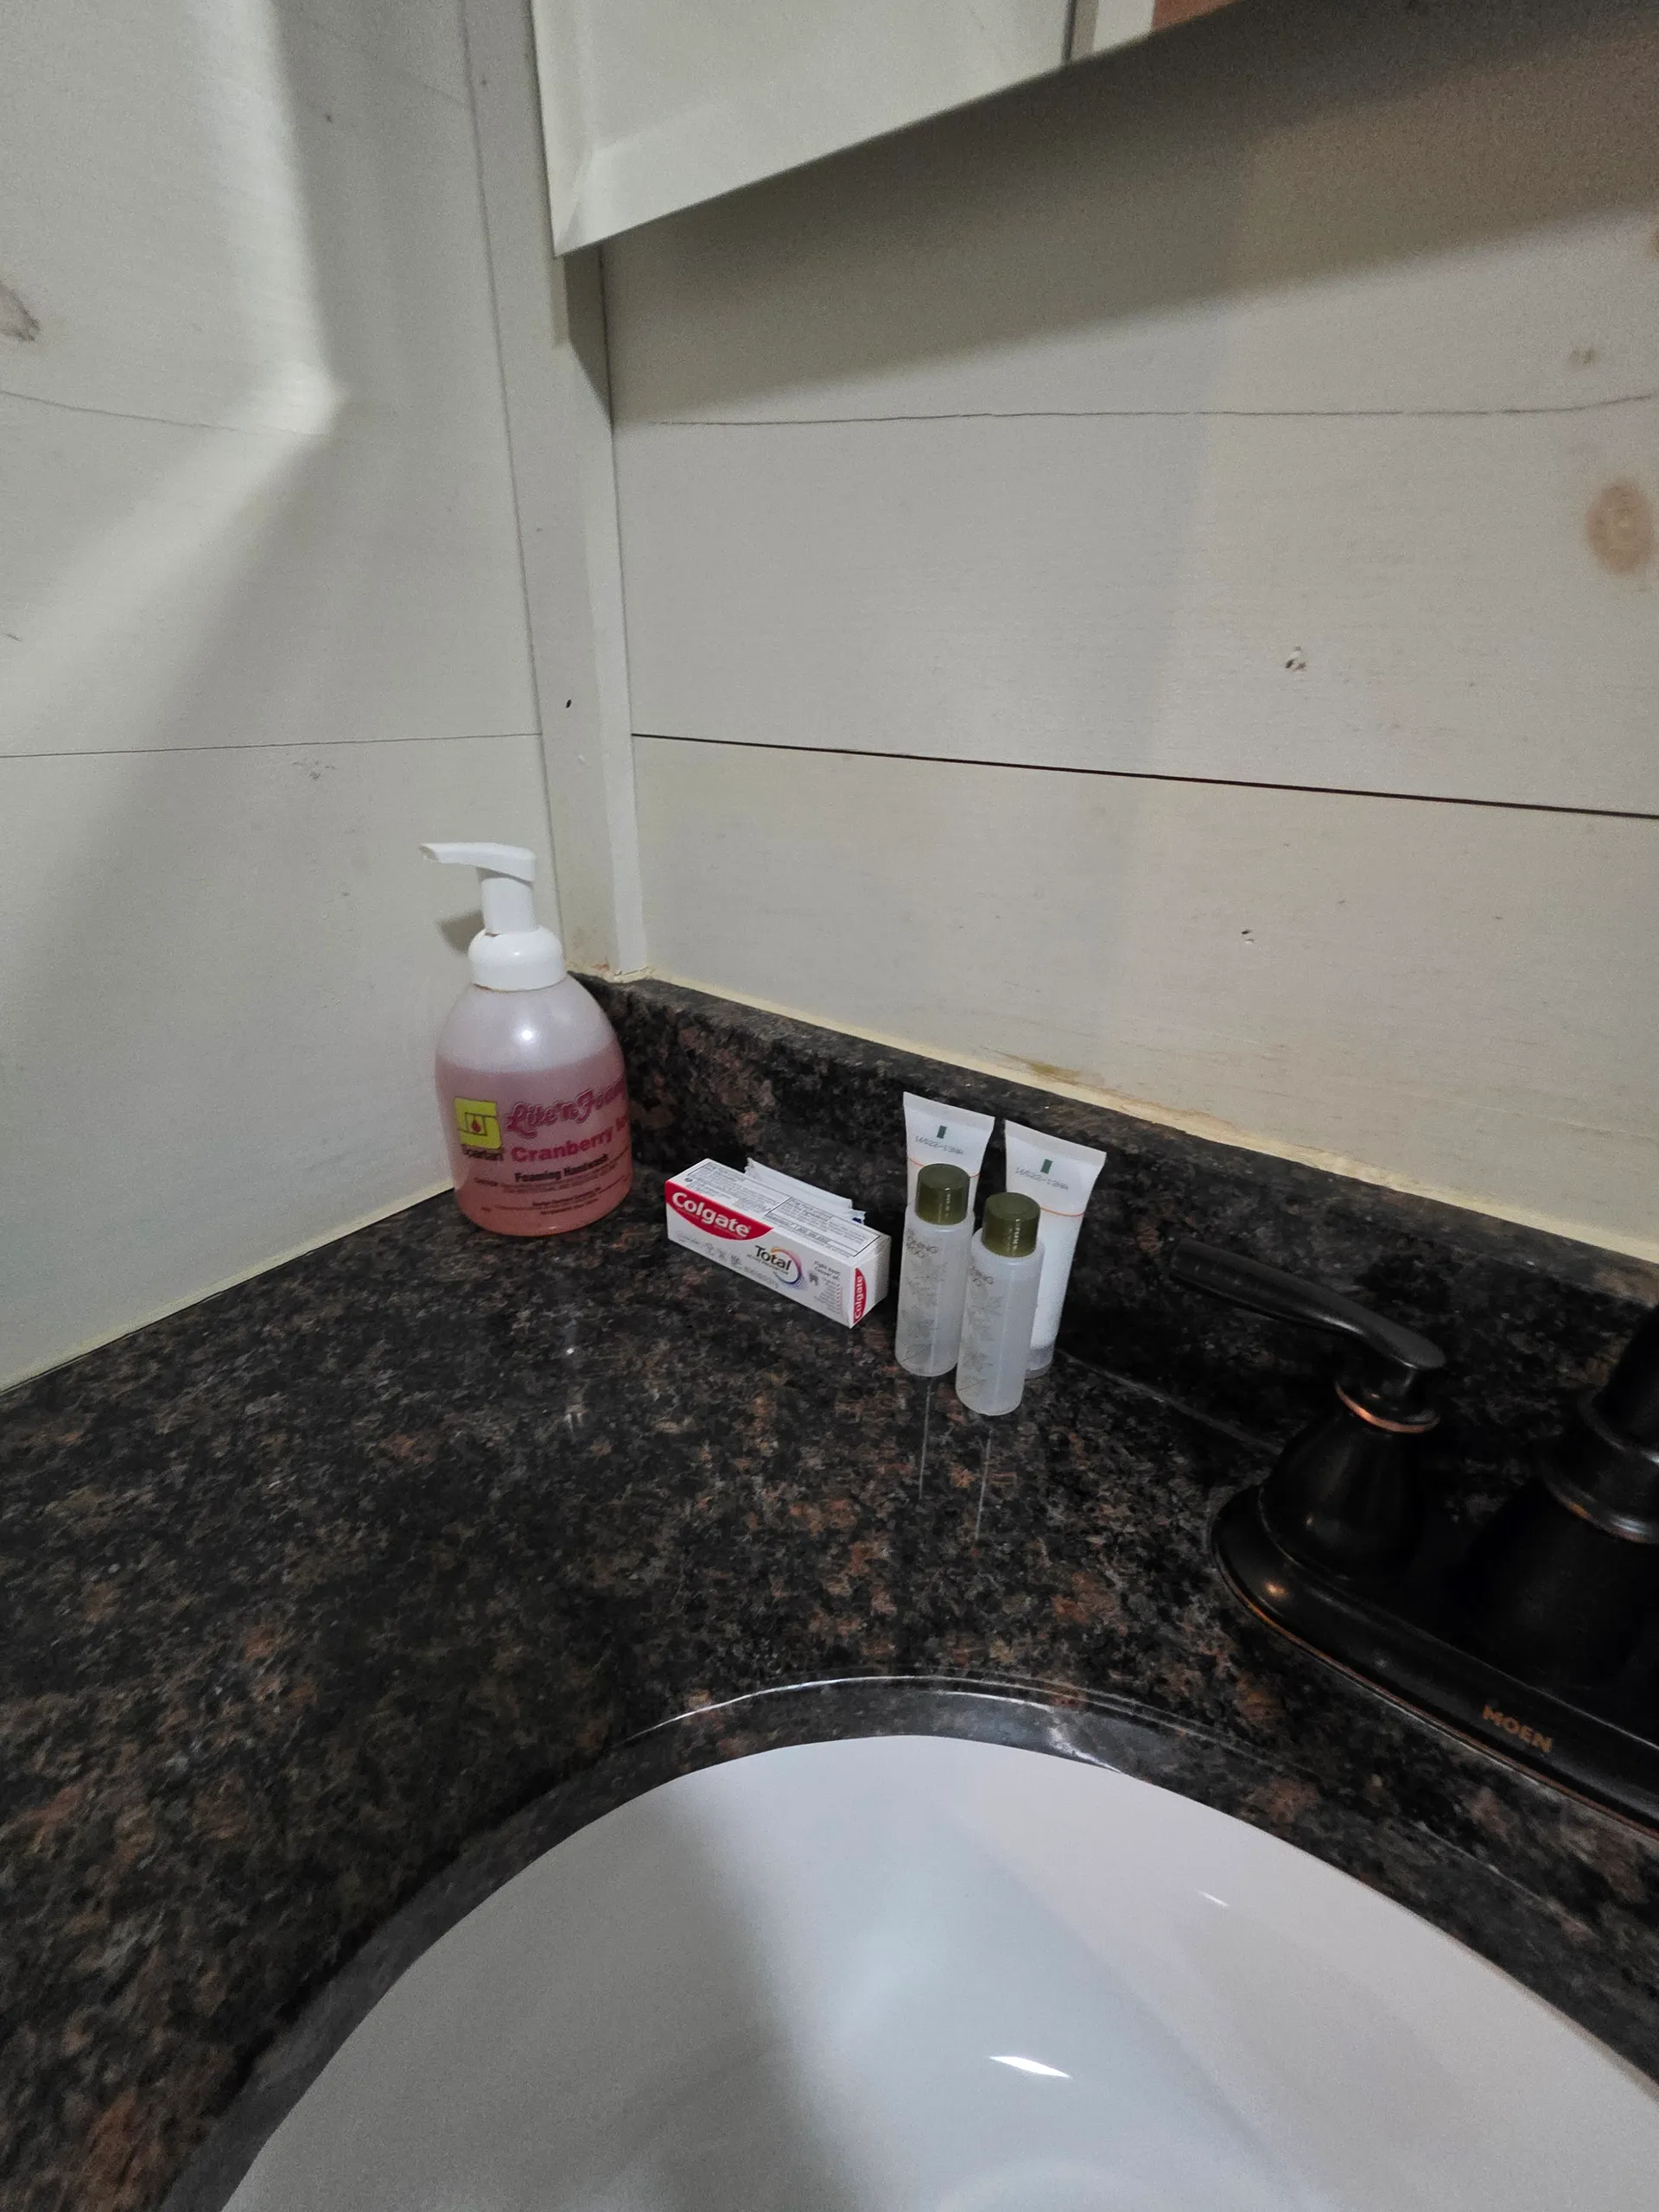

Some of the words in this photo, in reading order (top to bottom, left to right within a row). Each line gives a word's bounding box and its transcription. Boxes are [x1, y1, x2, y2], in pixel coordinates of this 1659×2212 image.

[511, 1126, 613, 1162] Cranberry
[671, 1192, 749, 1237] Colgate
[754, 1244, 792, 1271] Total
[854, 1275, 863, 1320] Colgate
[1482, 1704, 1553, 1753] MOEN
